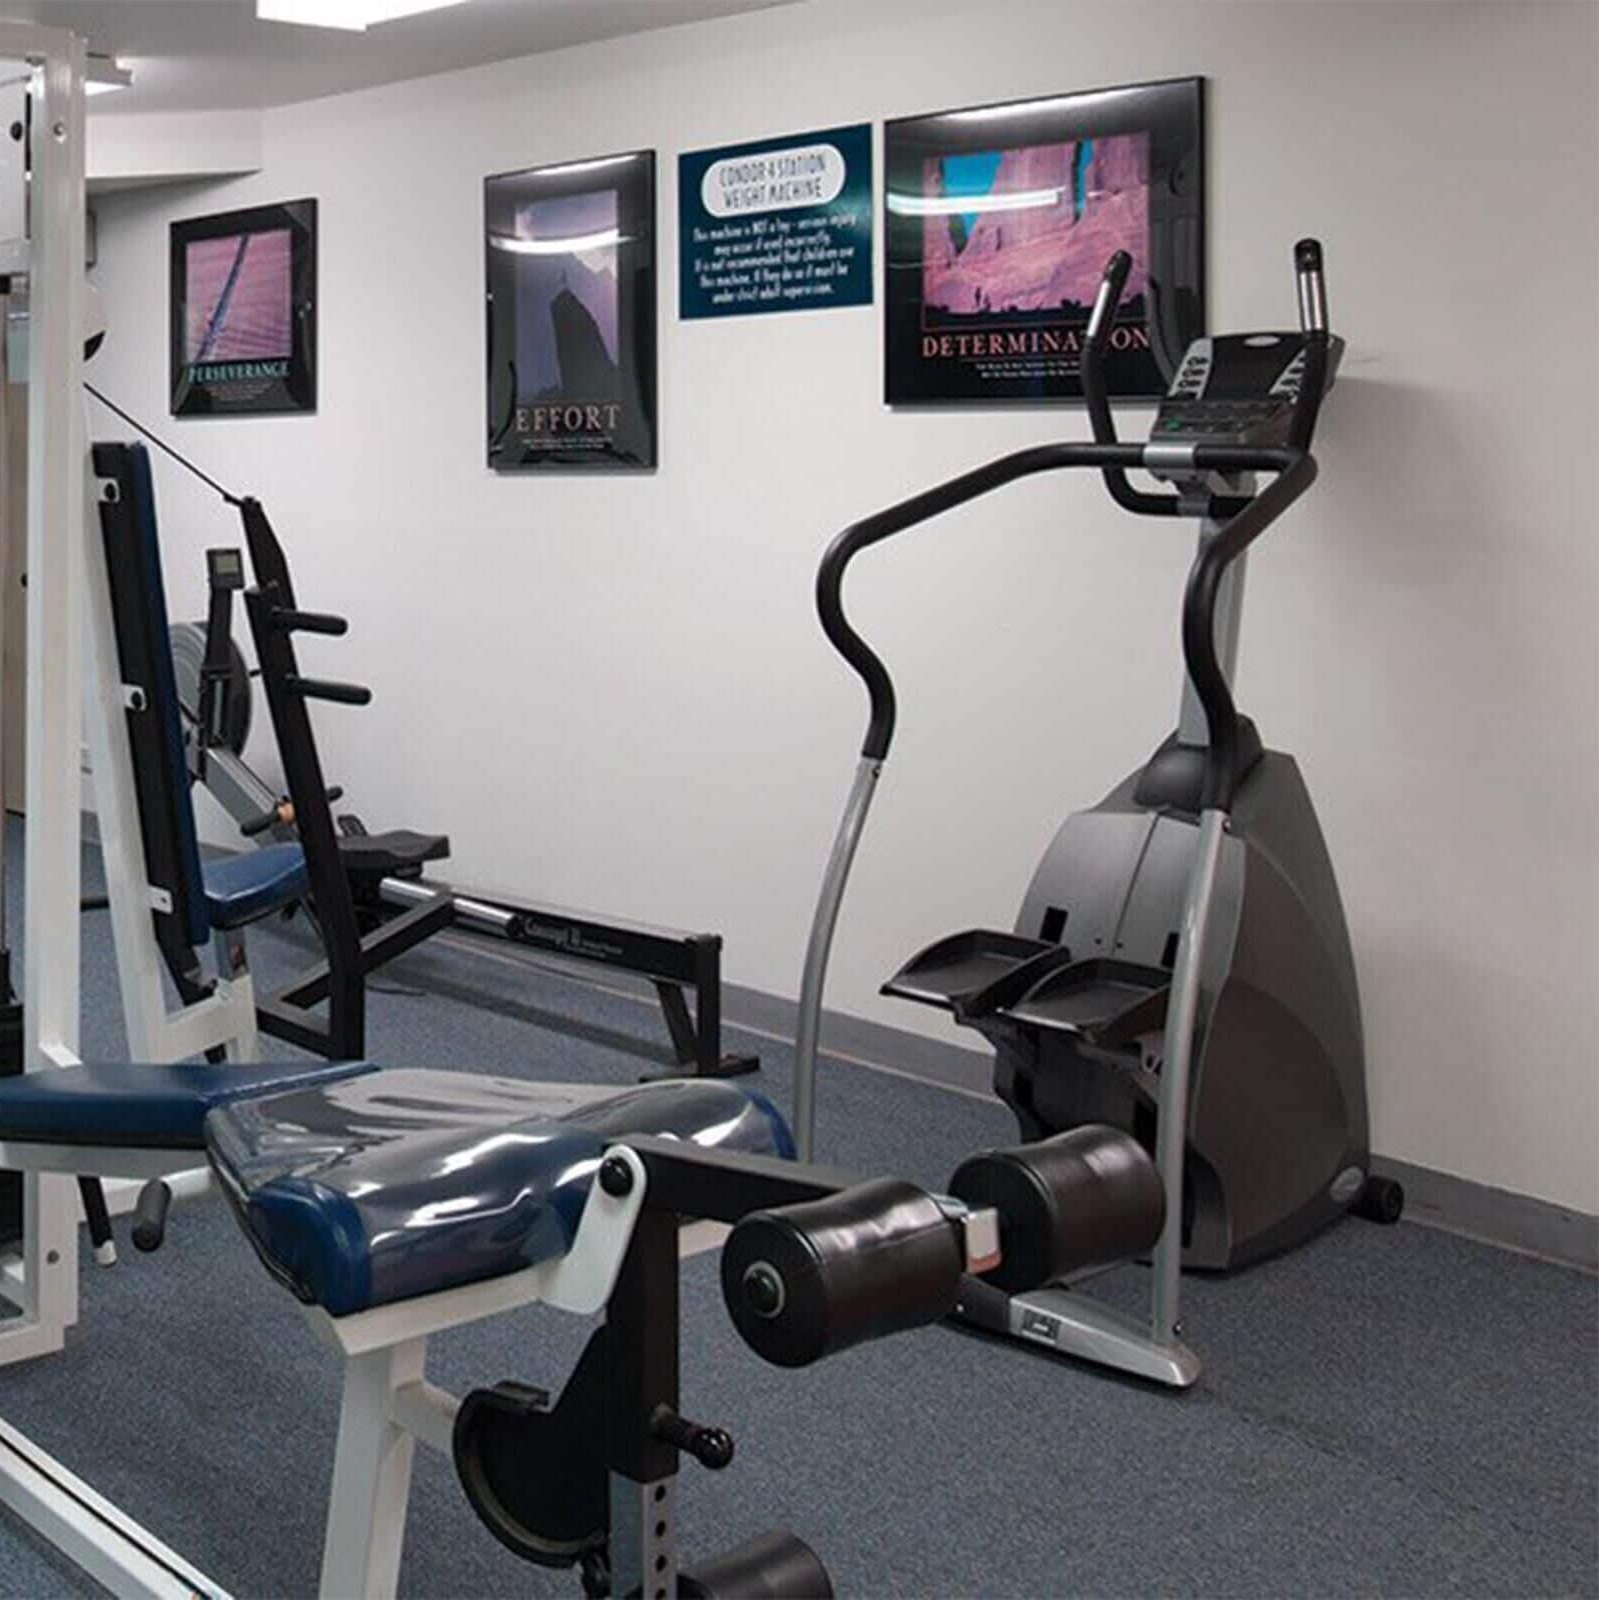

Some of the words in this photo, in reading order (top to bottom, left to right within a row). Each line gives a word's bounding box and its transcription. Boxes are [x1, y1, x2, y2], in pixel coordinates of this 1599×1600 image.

[720, 162, 765, 188] CONDOR
[778, 153, 825, 178] STATION
[723, 185, 766, 208] WEIGHT
[769, 176, 822, 202] MACHINE
[752, 219, 769, 235] NOT
[921, 328, 1150, 358] DETERMINAON
[188, 361, 291, 384] PERSEVERANCE
[515, 404, 621, 432] EFFORT
